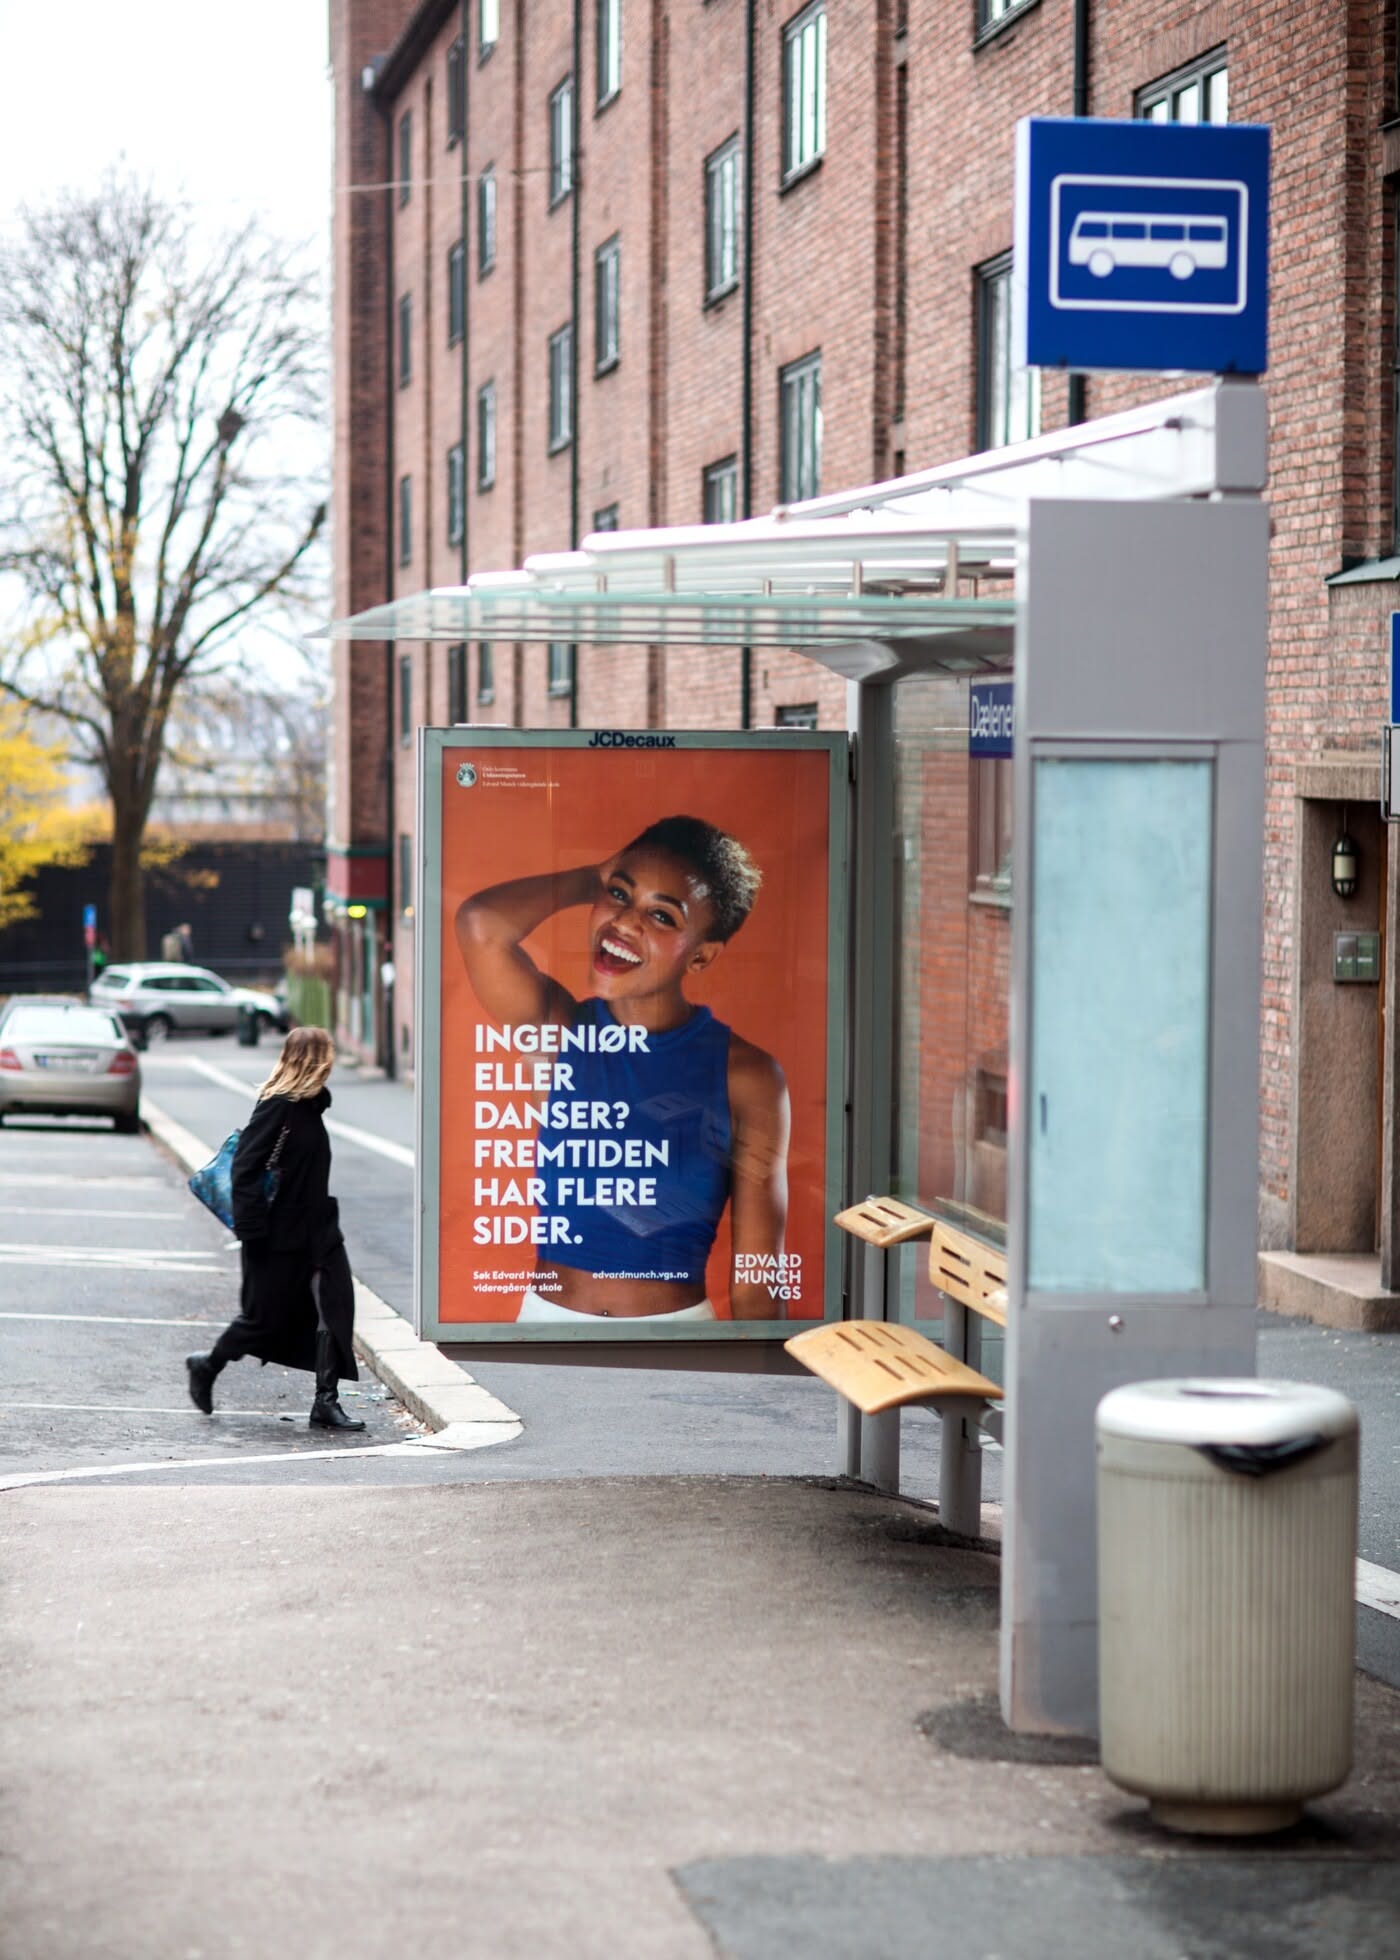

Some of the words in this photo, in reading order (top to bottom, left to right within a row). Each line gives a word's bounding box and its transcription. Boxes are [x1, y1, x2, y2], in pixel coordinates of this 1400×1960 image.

[971, 691, 1016, 738] Dælene
[588, 731, 676, 748] JCDecaux
[475, 1024, 651, 1053] INGENIØR
[475, 1063, 576, 1091] ELLER
[474, 1101, 630, 1129] DANSER?
[474, 1139, 669, 1168] FREMTIDEN
[474, 1178, 549, 1206] HAR
[557, 1178, 657, 1206] FLERE
[473, 1216, 584, 1244] SIDER.
[735, 1253, 802, 1268] EDVARD
[473, 1270, 491, 1280] Søk
[492, 1270, 525, 1280] Edvard
[526, 1270, 558, 1280] Munch
[592, 1270, 689, 1281] edvardmunch.vgs.no
[734, 1269, 802, 1284] MUNCH
[473, 1283, 537, 1294] videregående
[538, 1283, 563, 1292] skole
[767, 1285, 802, 1300] VGS
